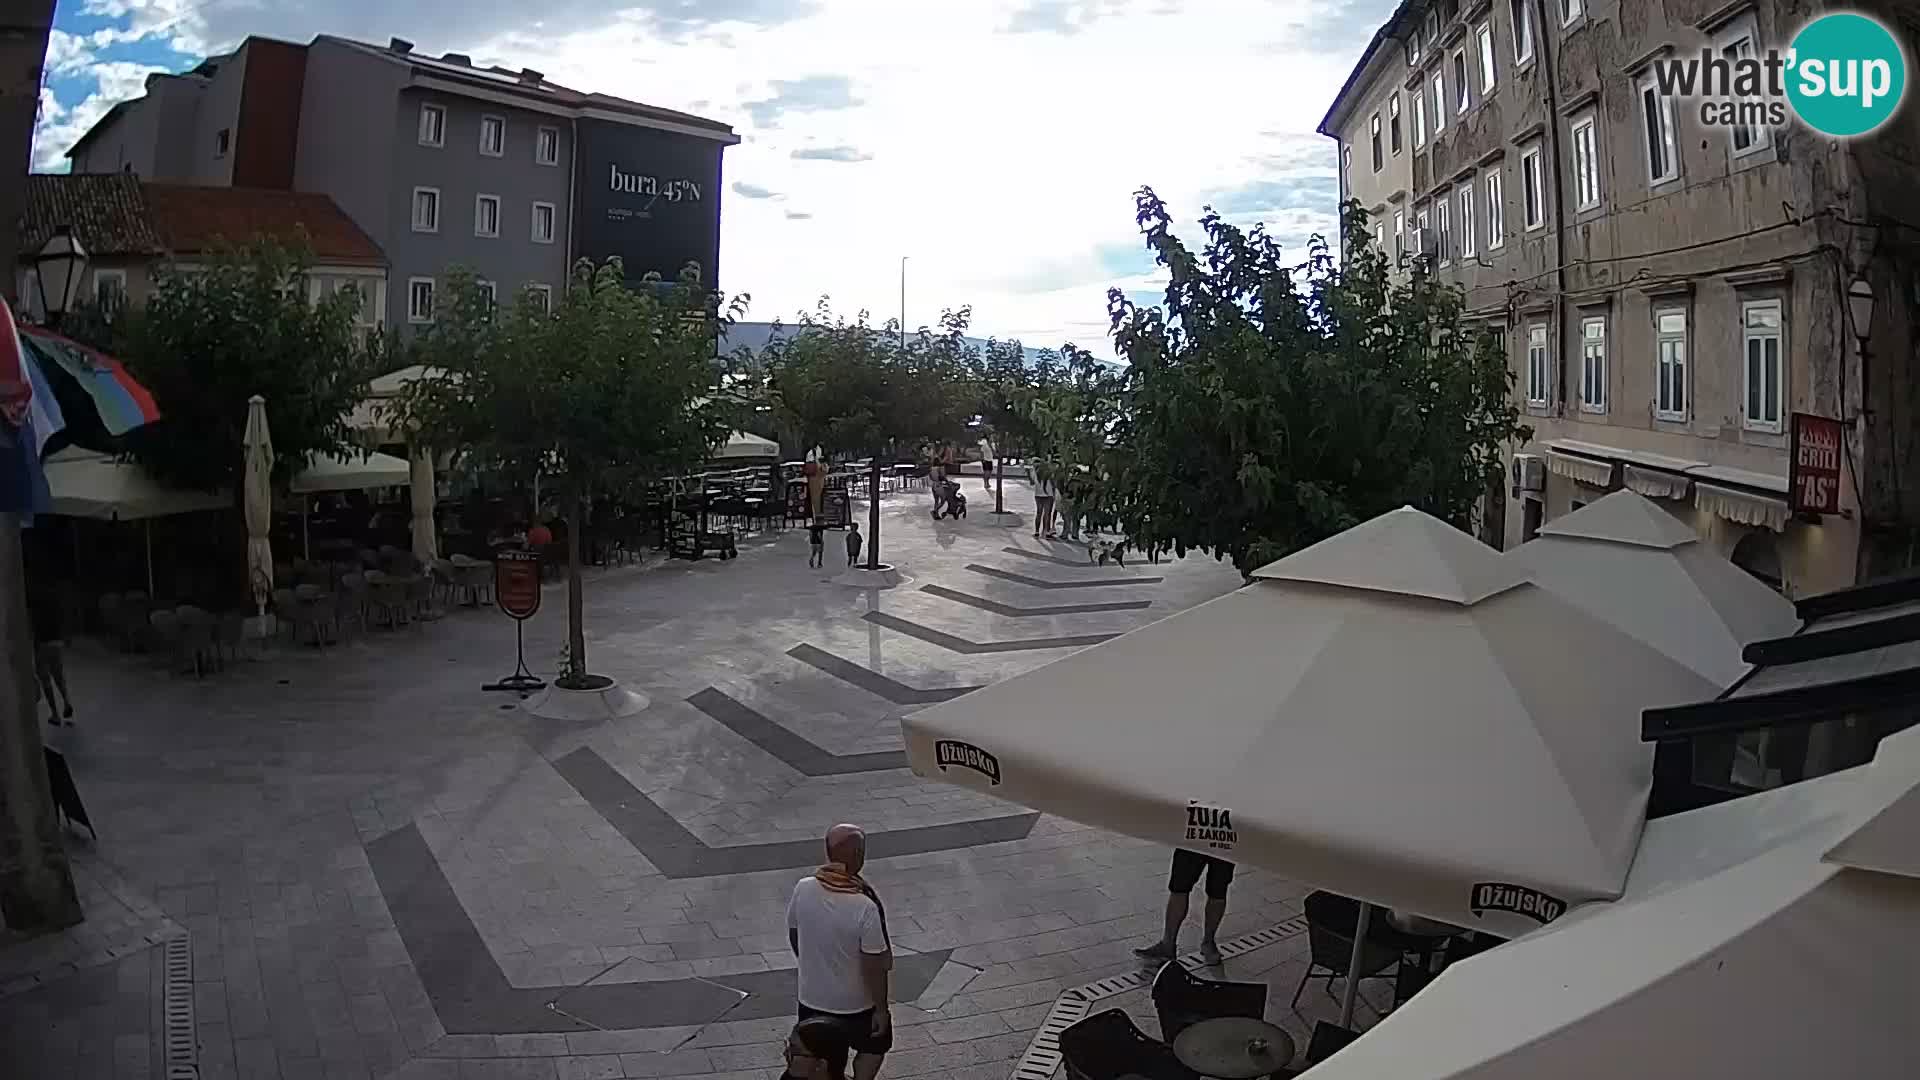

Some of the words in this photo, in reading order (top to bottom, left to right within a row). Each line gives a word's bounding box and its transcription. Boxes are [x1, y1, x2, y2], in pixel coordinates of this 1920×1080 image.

[610, 164, 657, 196] bura
[1798, 447, 1839, 470] GRILL
[1797, 475, 1837, 508] "AS"
[940, 742, 995, 775] Ožujsko
[1186, 799, 1232, 830] ŽUJA
[1185, 827, 1197, 840] JE
[1479, 885, 1560, 921] Ožujsko
